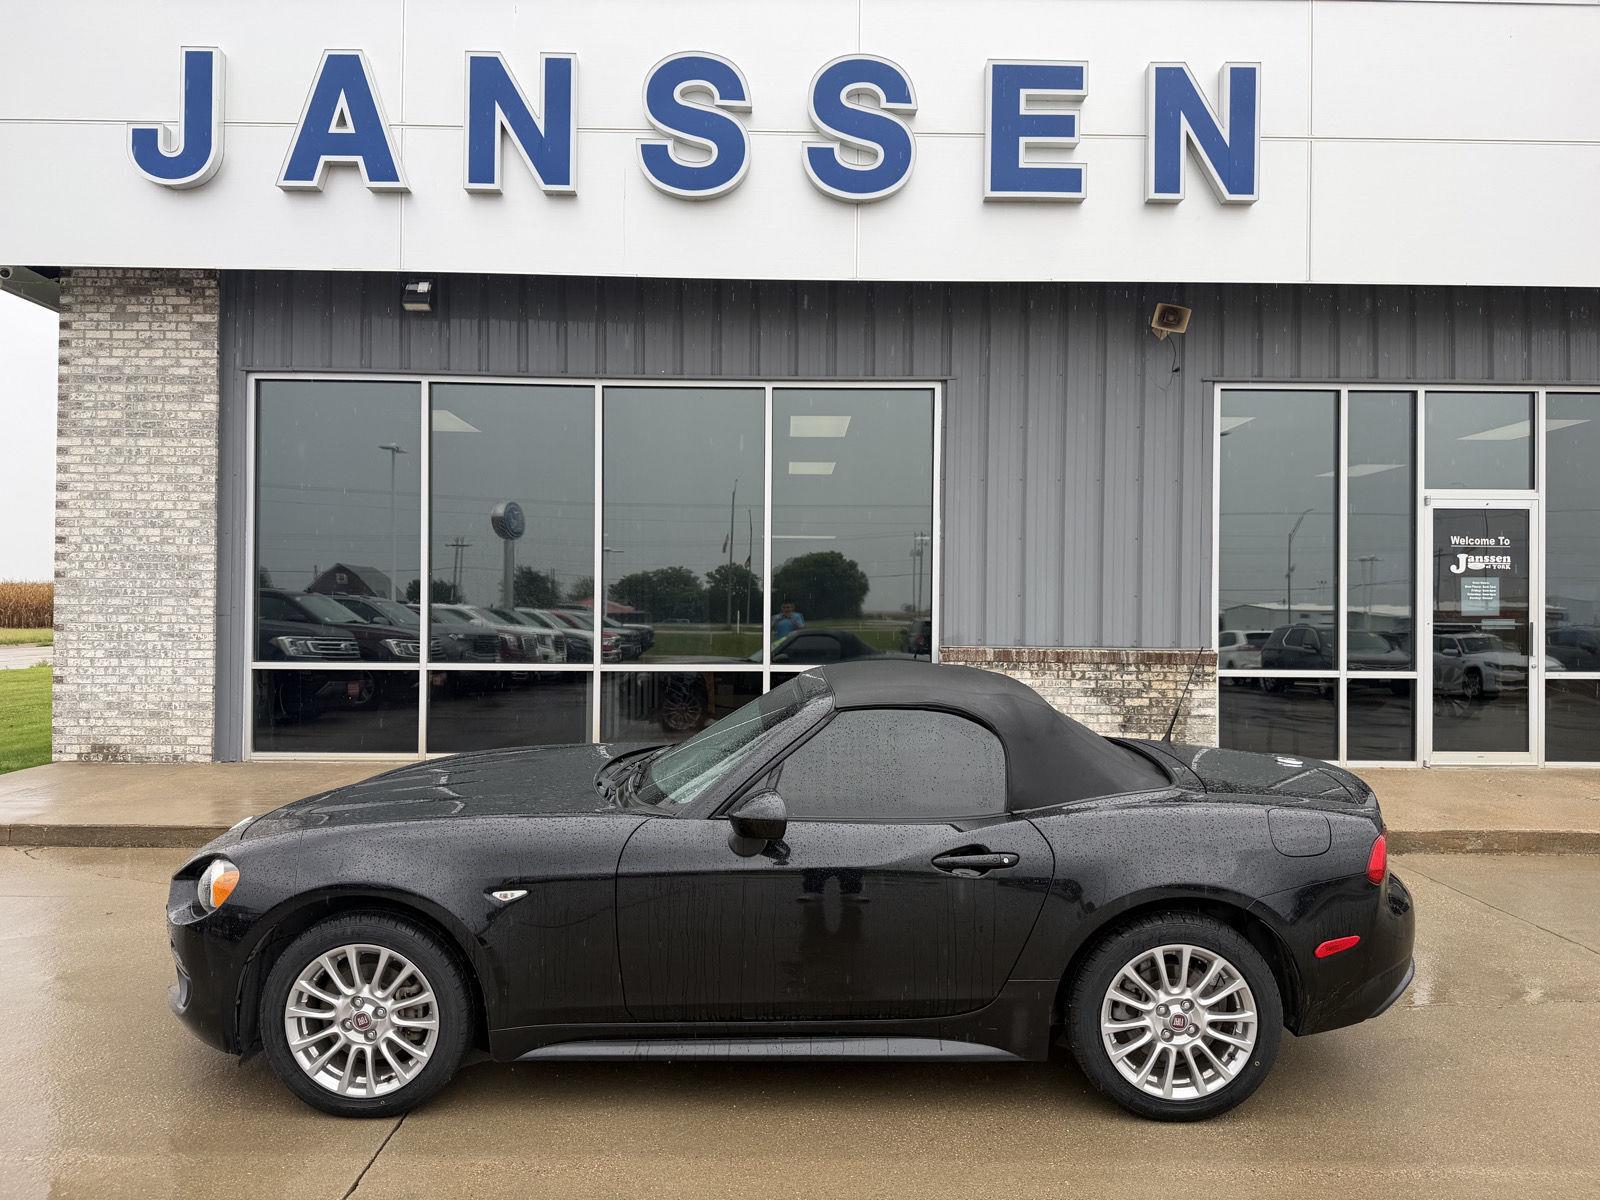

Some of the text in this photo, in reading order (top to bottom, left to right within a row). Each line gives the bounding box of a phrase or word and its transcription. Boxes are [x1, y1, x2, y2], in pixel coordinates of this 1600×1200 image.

[127, 46, 1261, 205] JANSSEN
[1450, 535, 1510, 546] Welcome To
[1450, 553, 1511, 574] Janssen
